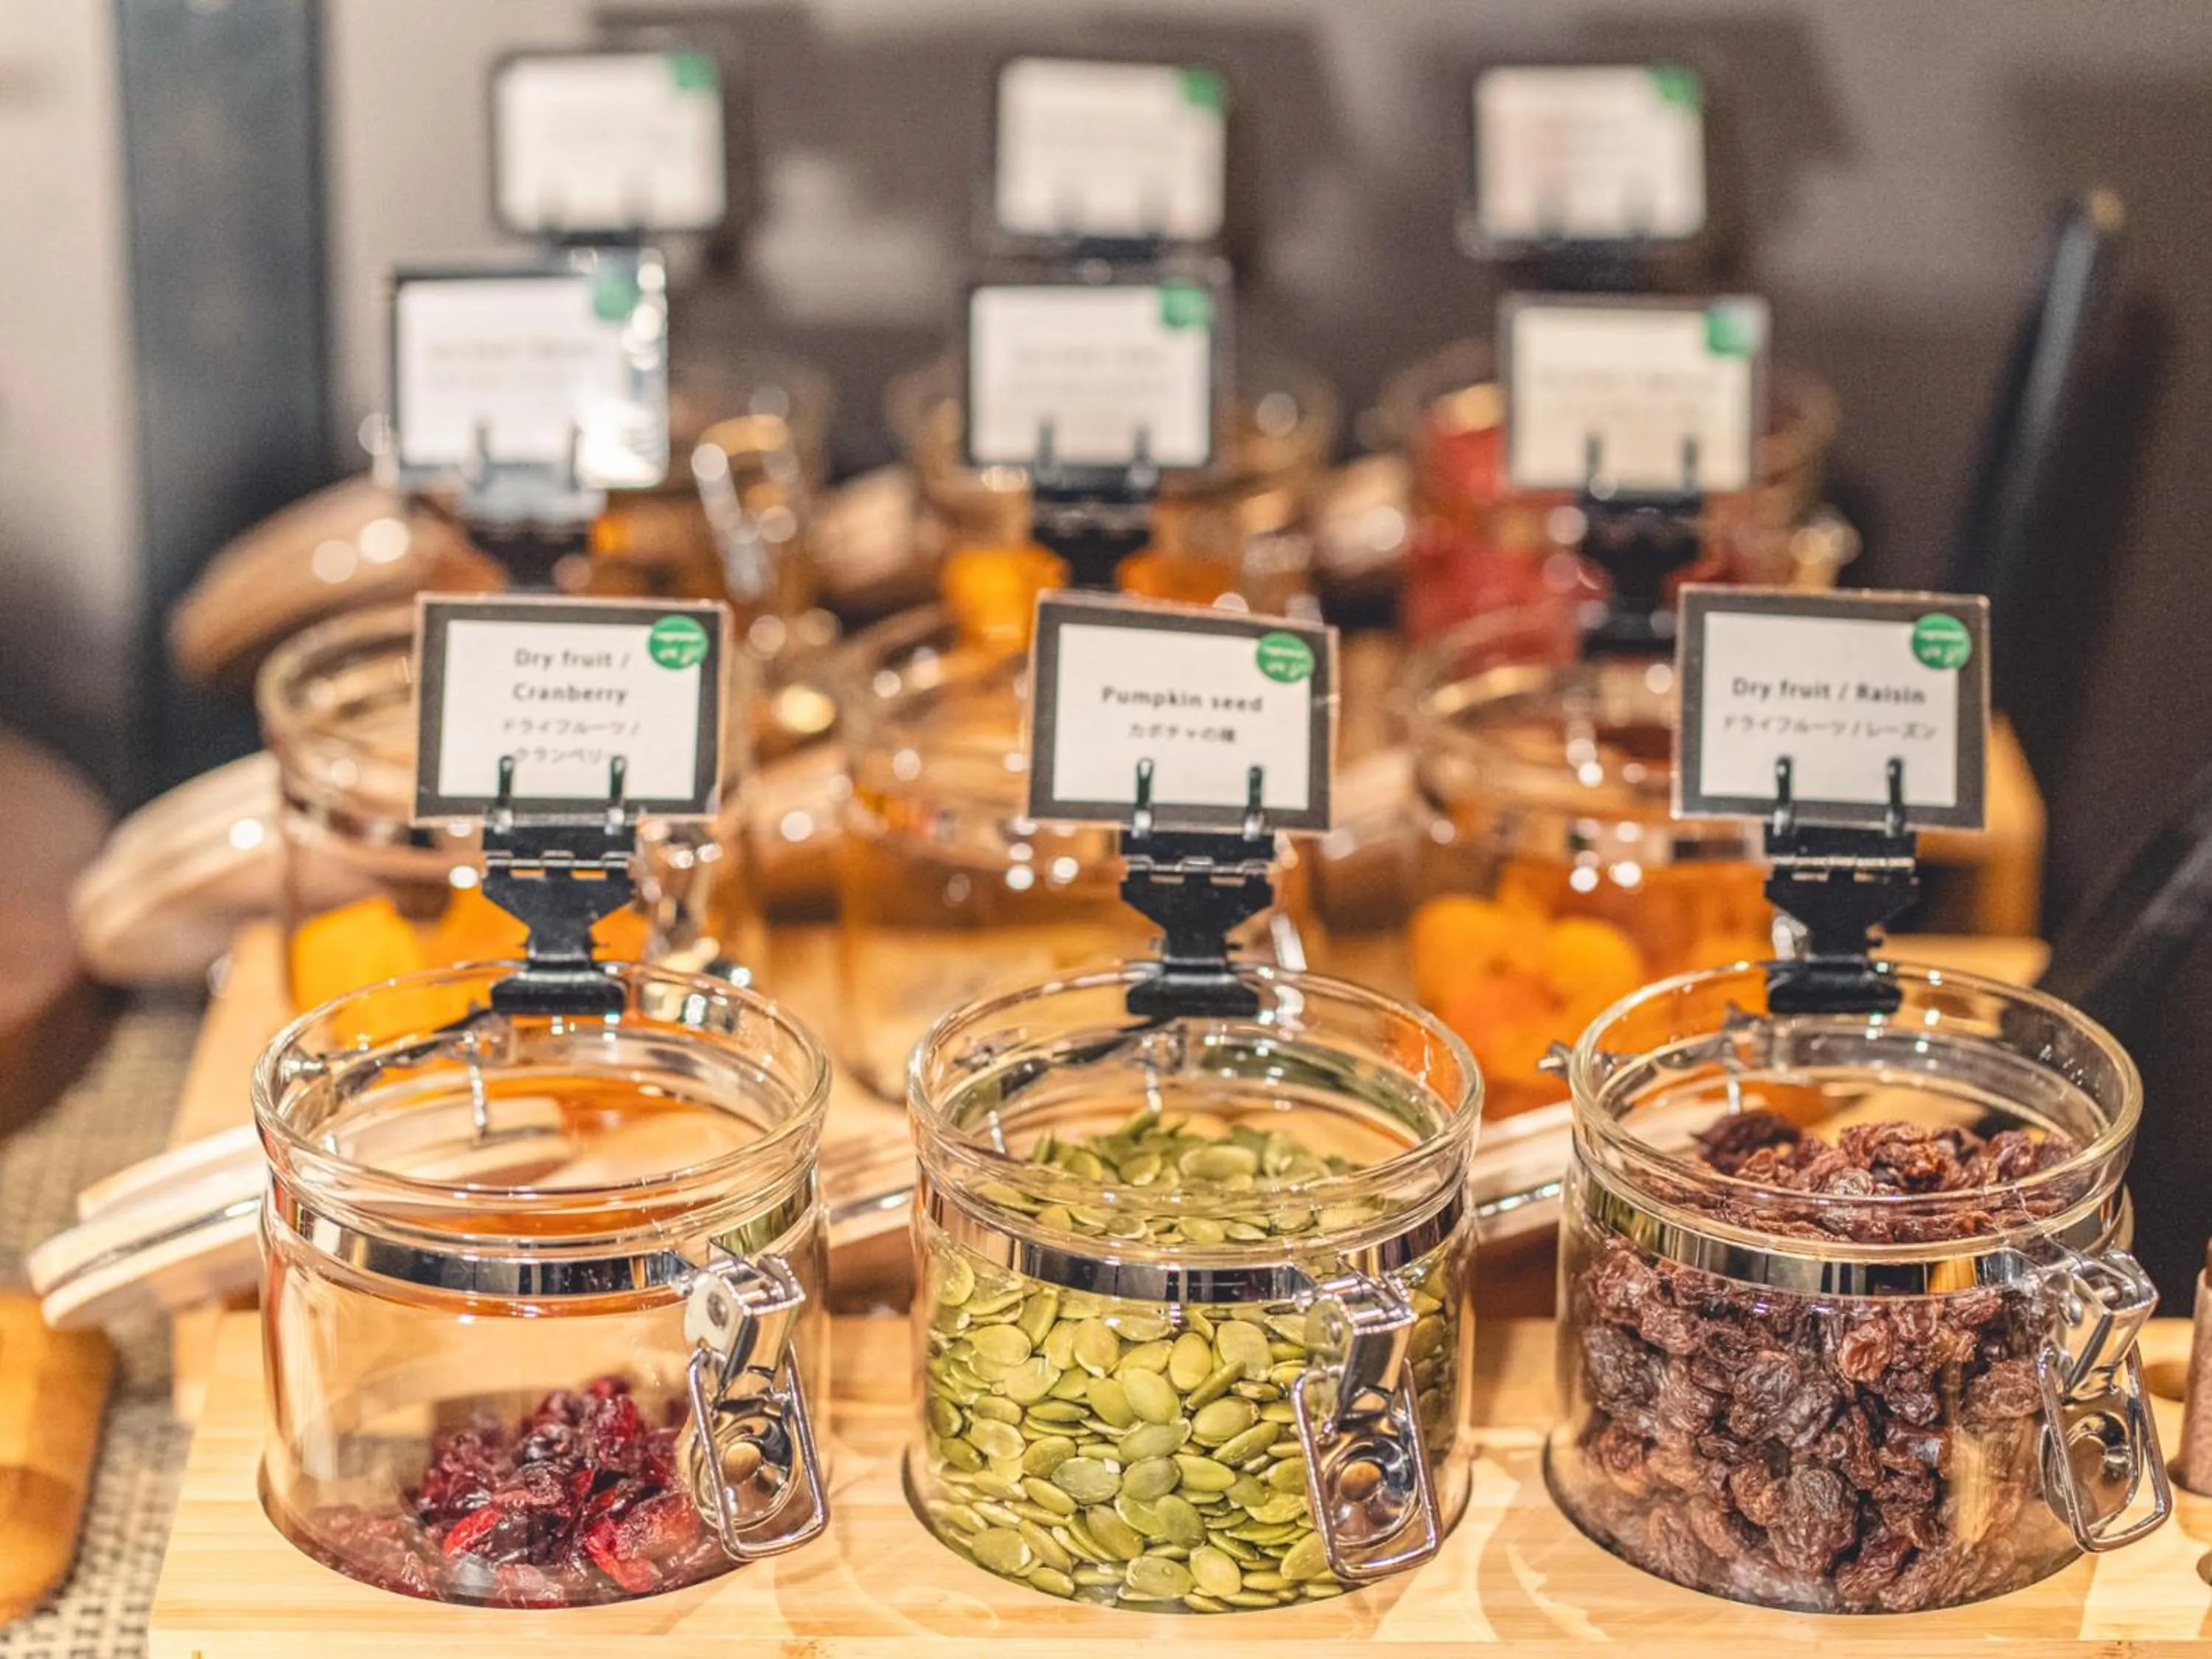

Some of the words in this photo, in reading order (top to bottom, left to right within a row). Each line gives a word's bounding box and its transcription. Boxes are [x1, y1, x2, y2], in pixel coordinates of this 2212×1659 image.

[514, 648, 553, 669] Dry
[561, 649, 613, 669] fruit
[512, 682, 629, 706] Cranberry
[1102, 685, 1203, 709] Pumpkin
[1211, 695, 1263, 712] seed
[1732, 676, 1772, 702] Dry
[1779, 678, 1831, 699] fruit
[1856, 681, 1927, 703] Raisin
